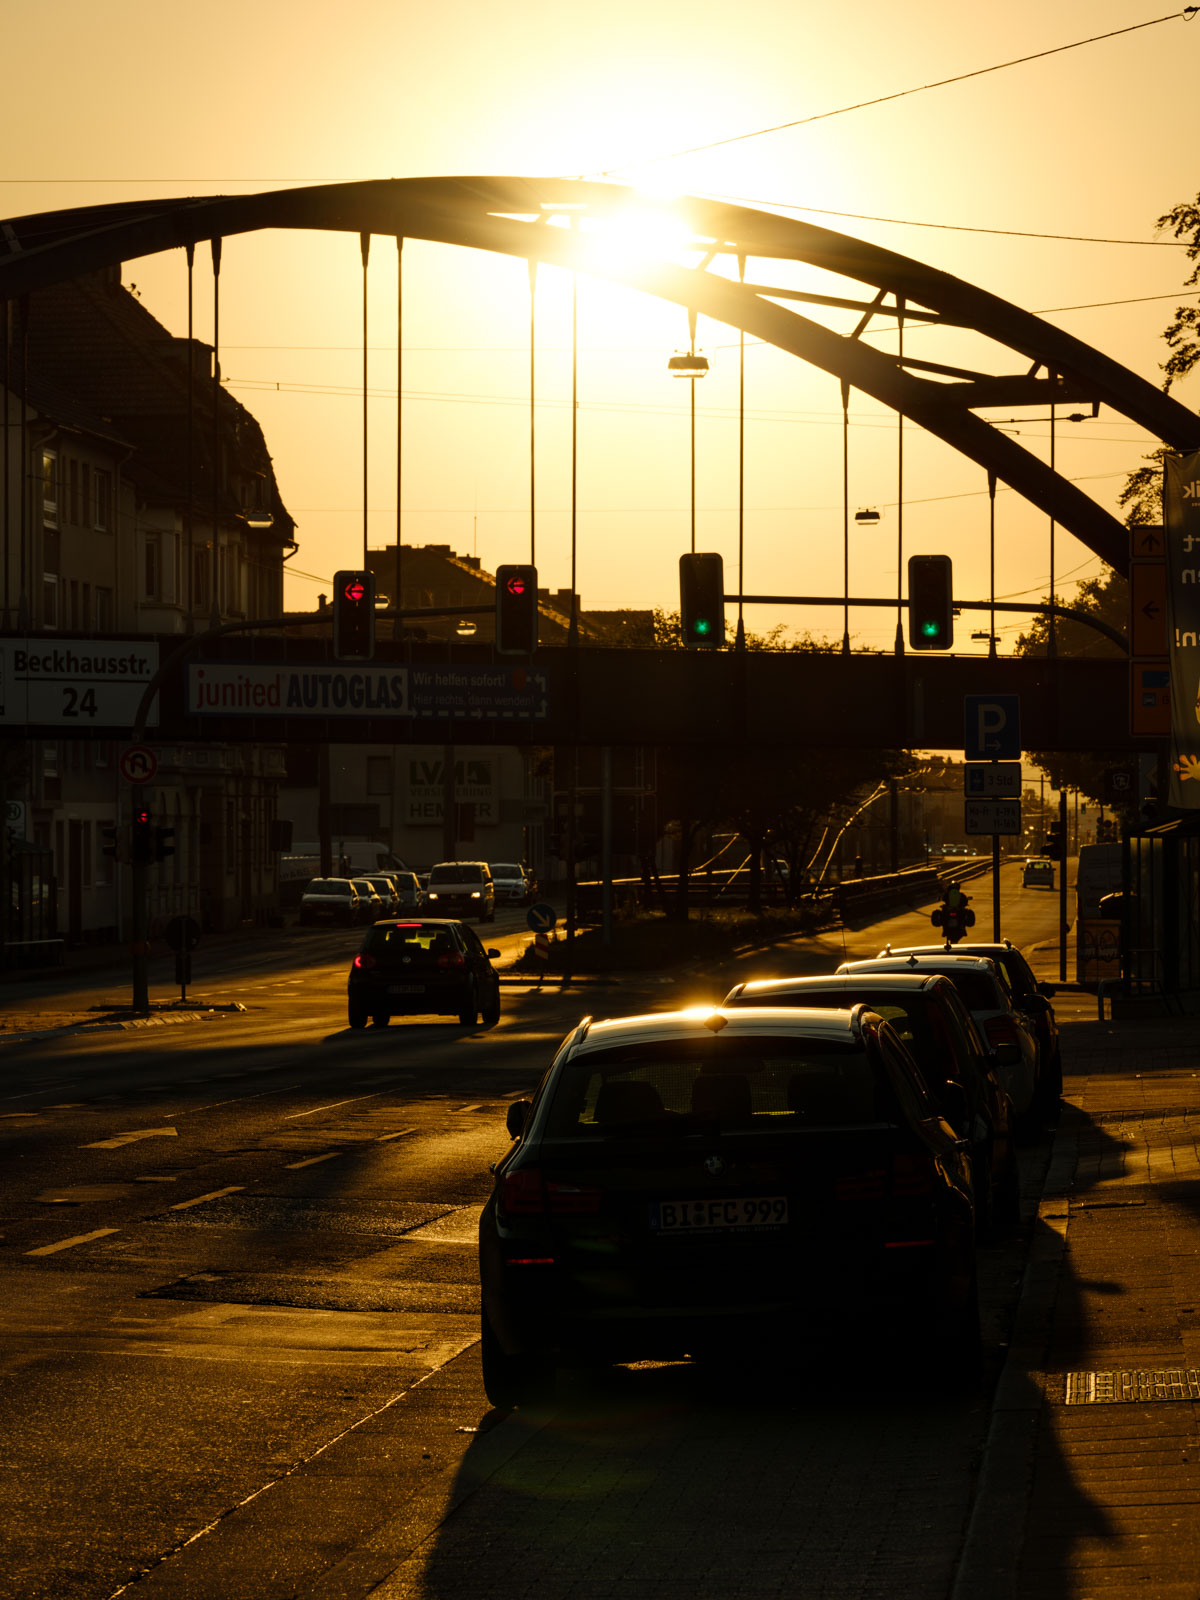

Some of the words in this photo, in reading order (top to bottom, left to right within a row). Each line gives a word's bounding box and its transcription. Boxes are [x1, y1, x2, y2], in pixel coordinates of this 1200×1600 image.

[14, 650, 150, 674] Beckhausstr.
[196, 668, 281, 709] junited
[286, 672, 404, 709] AUTOGLAS
[412, 671, 433, 685] Wir
[435, 672, 467, 687] helfen
[470, 673, 506, 688] sofort!
[62, 687, 98, 717] 24
[977, 703, 1007, 753] P
[662, 1205, 691, 1226] BI
[708, 1202, 738, 1225] FC
[743, 1200, 786, 1222] 999
